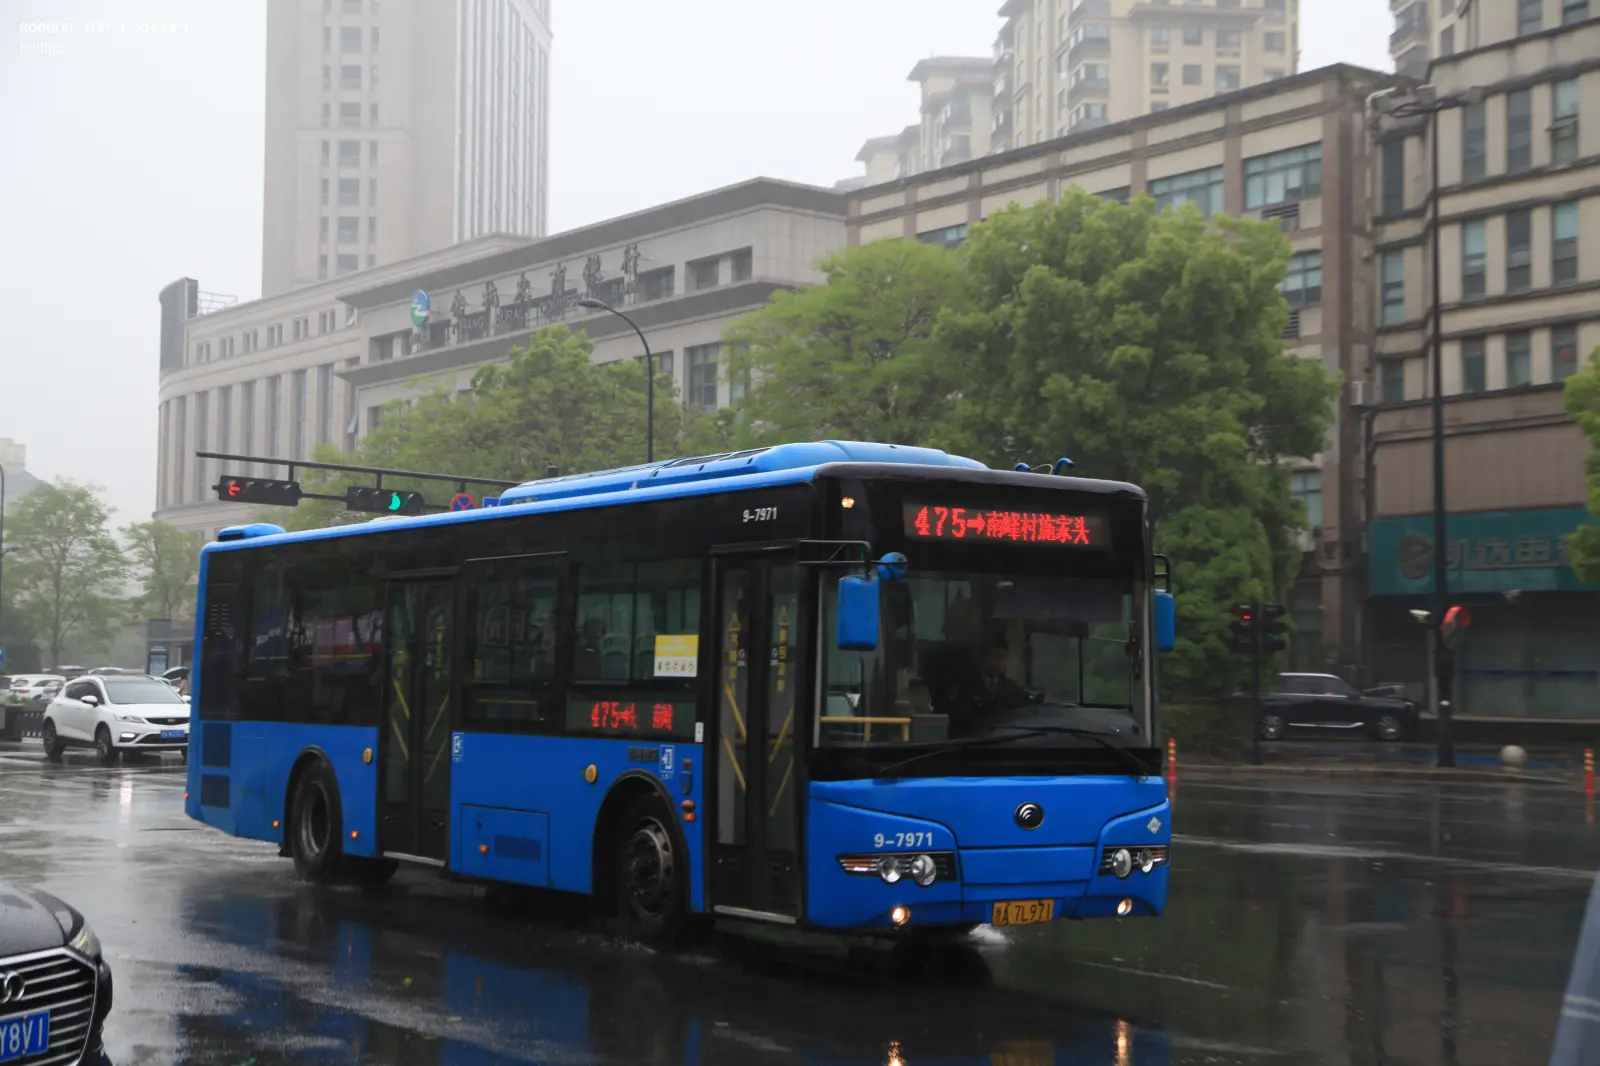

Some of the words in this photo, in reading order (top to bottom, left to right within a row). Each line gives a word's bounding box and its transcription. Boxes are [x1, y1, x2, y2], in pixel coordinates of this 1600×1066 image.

[742, 506, 778, 523] 9-7971
[915, 505, 965, 538] 475
[873, 831, 934, 848] 9-7971
